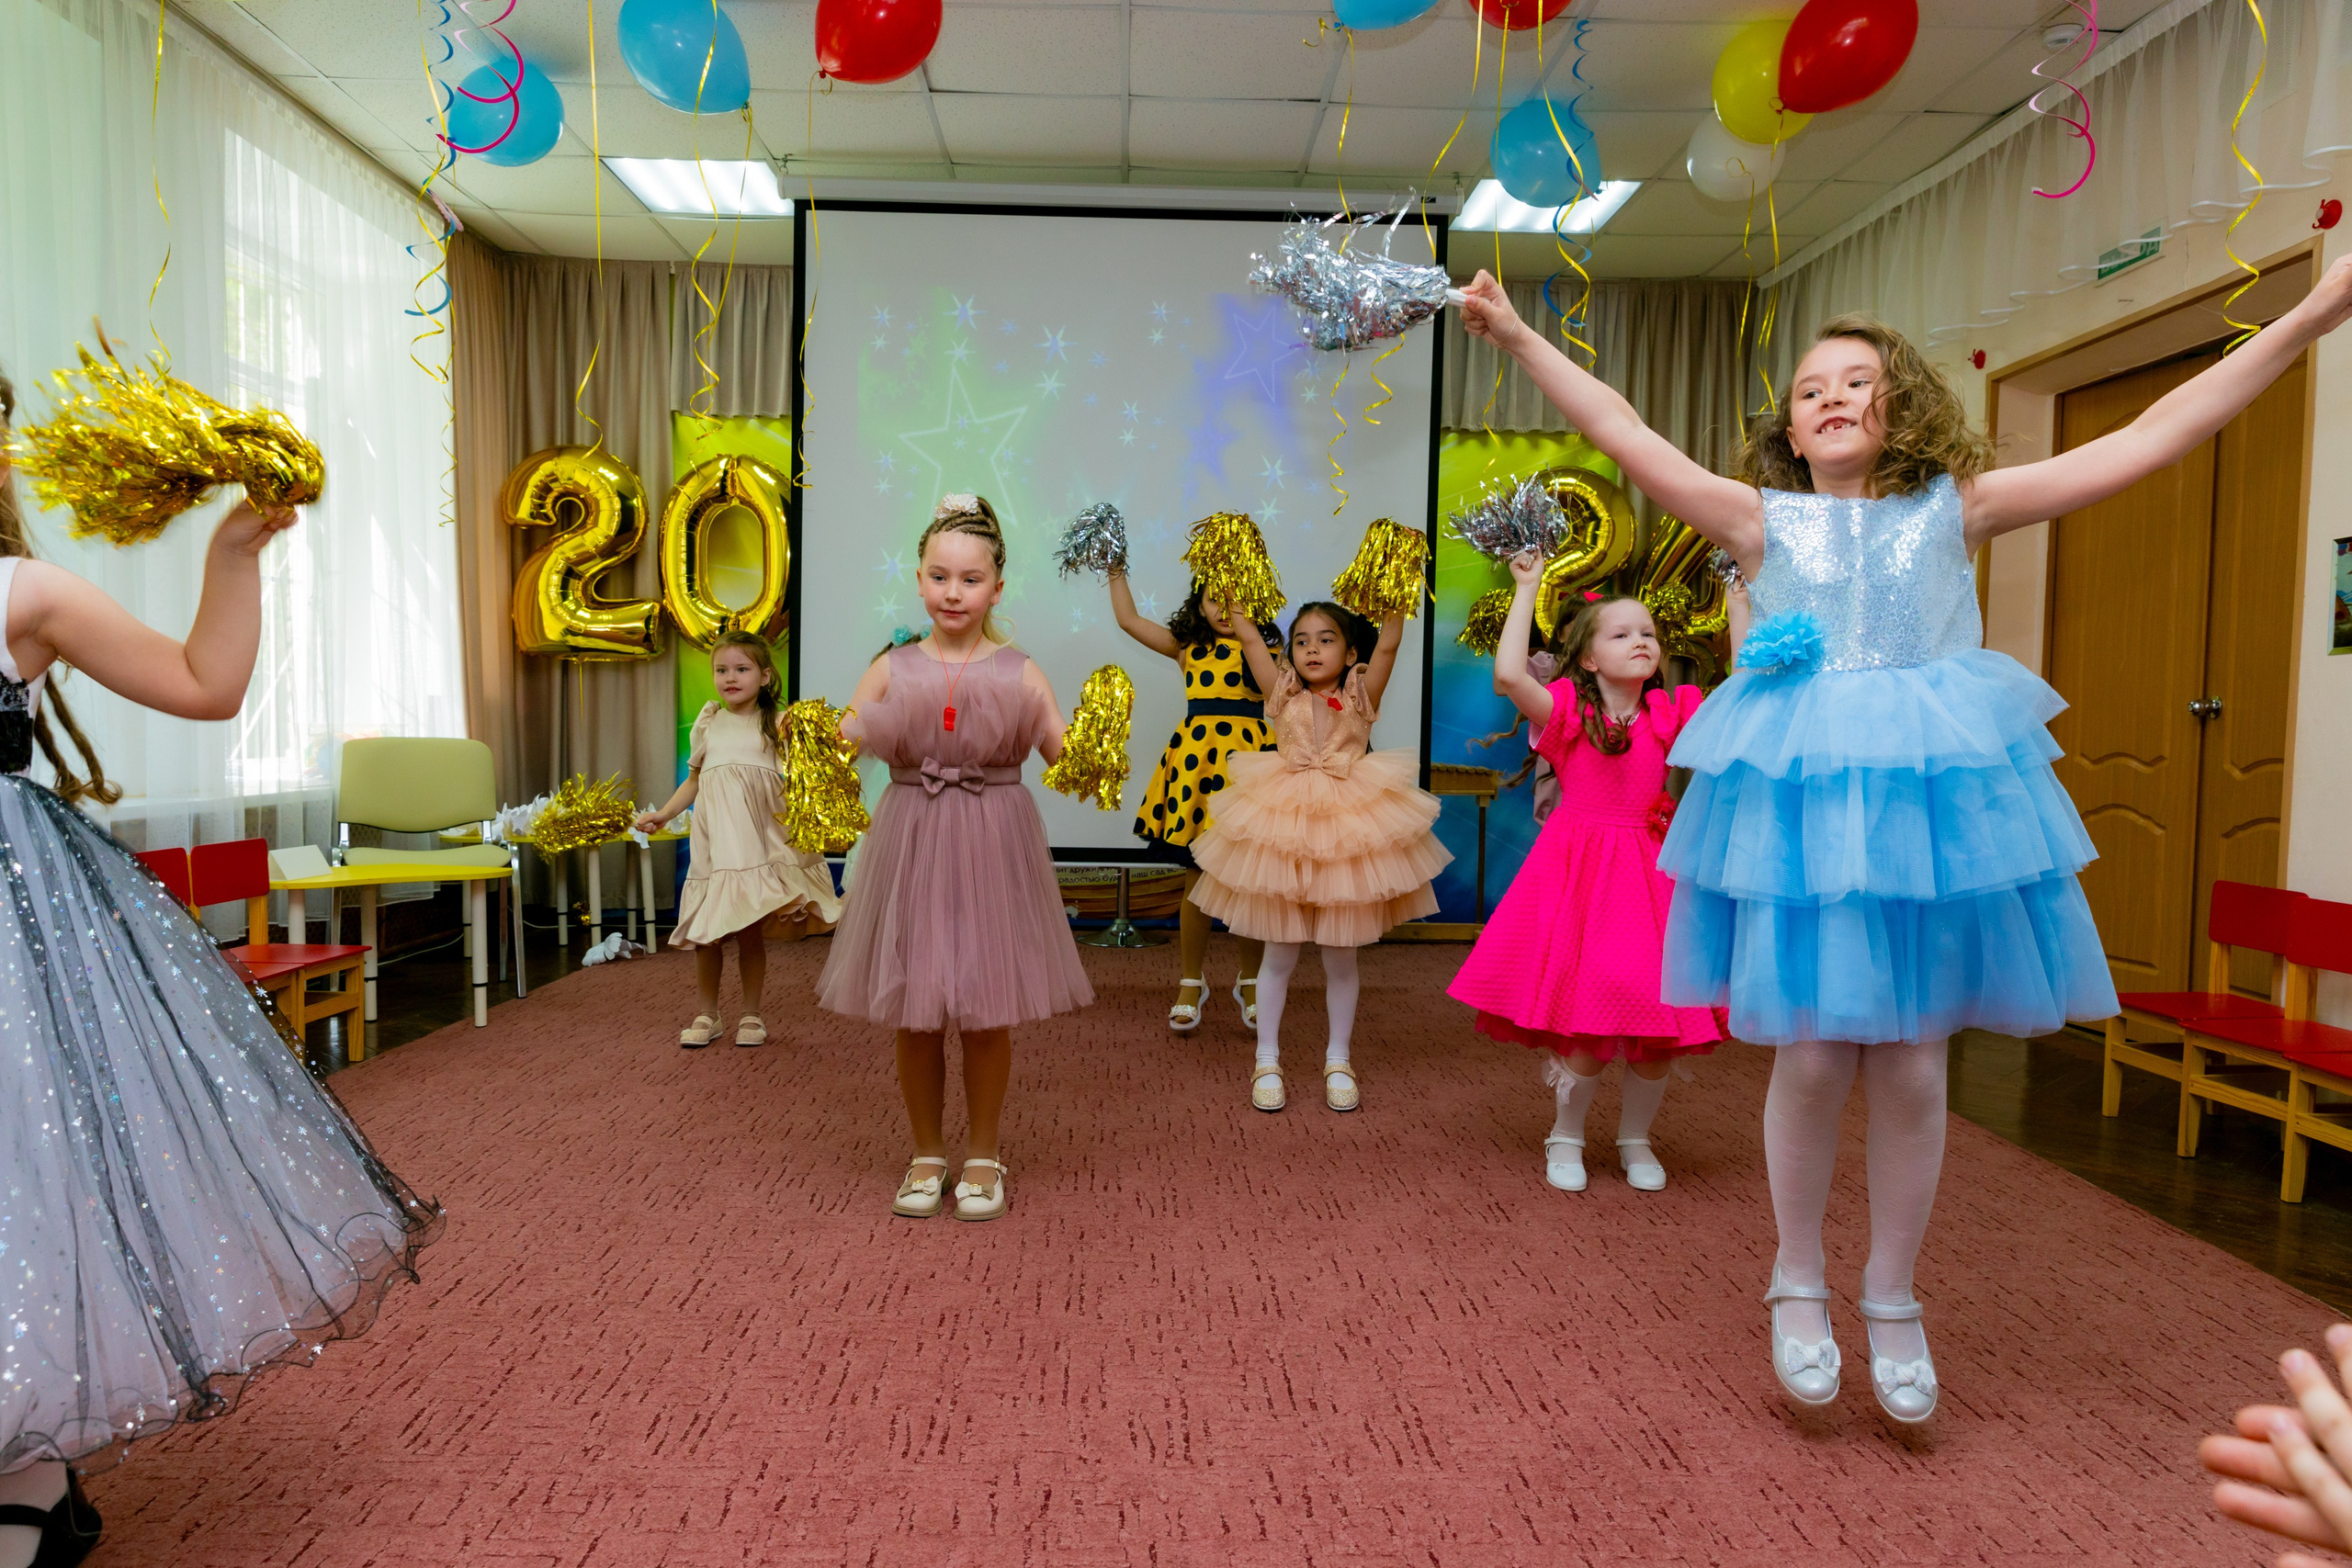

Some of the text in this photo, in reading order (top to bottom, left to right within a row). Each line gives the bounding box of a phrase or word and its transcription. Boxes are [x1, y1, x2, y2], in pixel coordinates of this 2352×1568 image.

[502, 446, 791, 662] 20
[1058, 876, 1101, 885] радостью
[1131, 871, 1148, 879] наш
